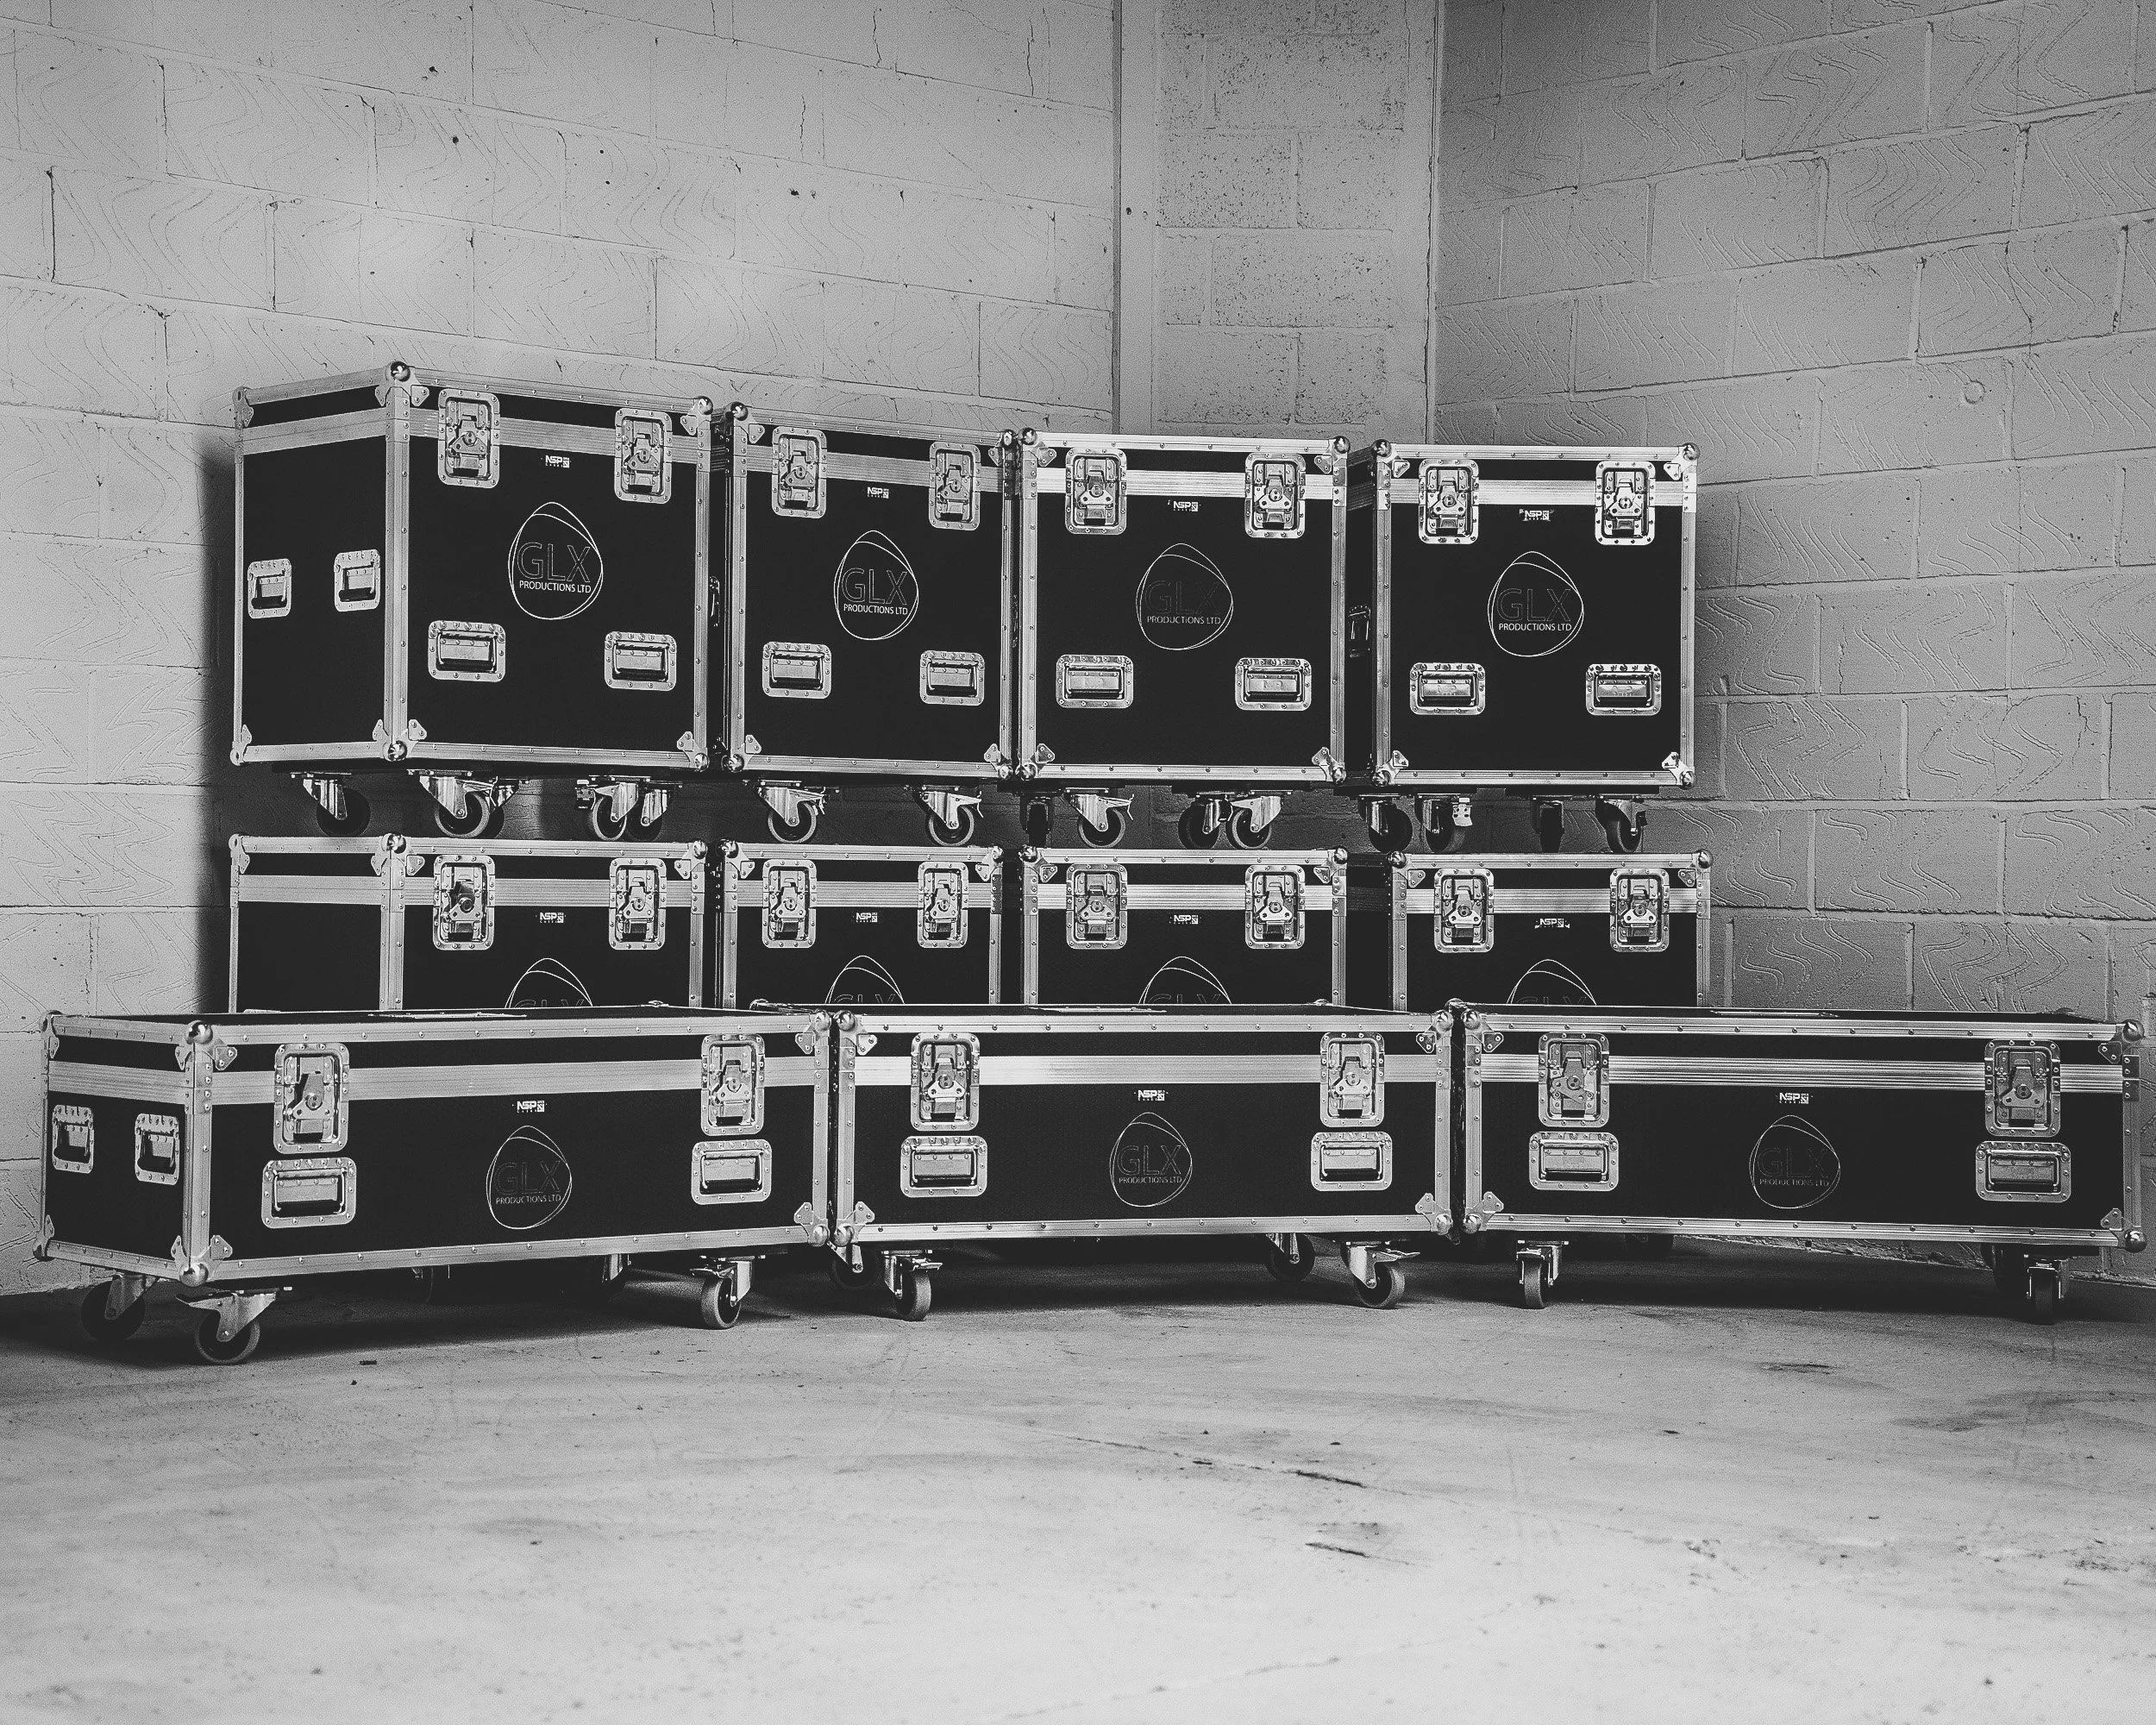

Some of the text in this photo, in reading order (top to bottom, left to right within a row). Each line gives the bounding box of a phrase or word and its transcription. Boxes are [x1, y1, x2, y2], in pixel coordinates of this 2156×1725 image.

[545, 455, 562, 464] NSP
[868, 486, 883, 495] NSP
[517, 542, 591, 583] GLX
[519, 580, 591, 593] PRODUCTIONS LTD
[842, 568, 908, 605] GLX
[1144, 580, 1220, 615] GLX
[843, 603, 908, 615] PRODUCTIONS LTD
[1496, 587, 1571, 621] GLX
[1147, 615, 1221, 624] PRODUCTIONS LTD
[1499, 623, 1556, 631] PRODUCTIONS
[1138, 1089, 1157, 1098] NSP
[517, 1101, 536, 1110] NSP
[1117, 1145, 1181, 1176] GLX
[1757, 1147, 1828, 1178] GLX
[494, 1160, 561, 1196] GLX
[1119, 1176, 1169, 1184] PRODUCTIONS
[496, 1194, 561, 1205] PRODUCTIONS LTD
